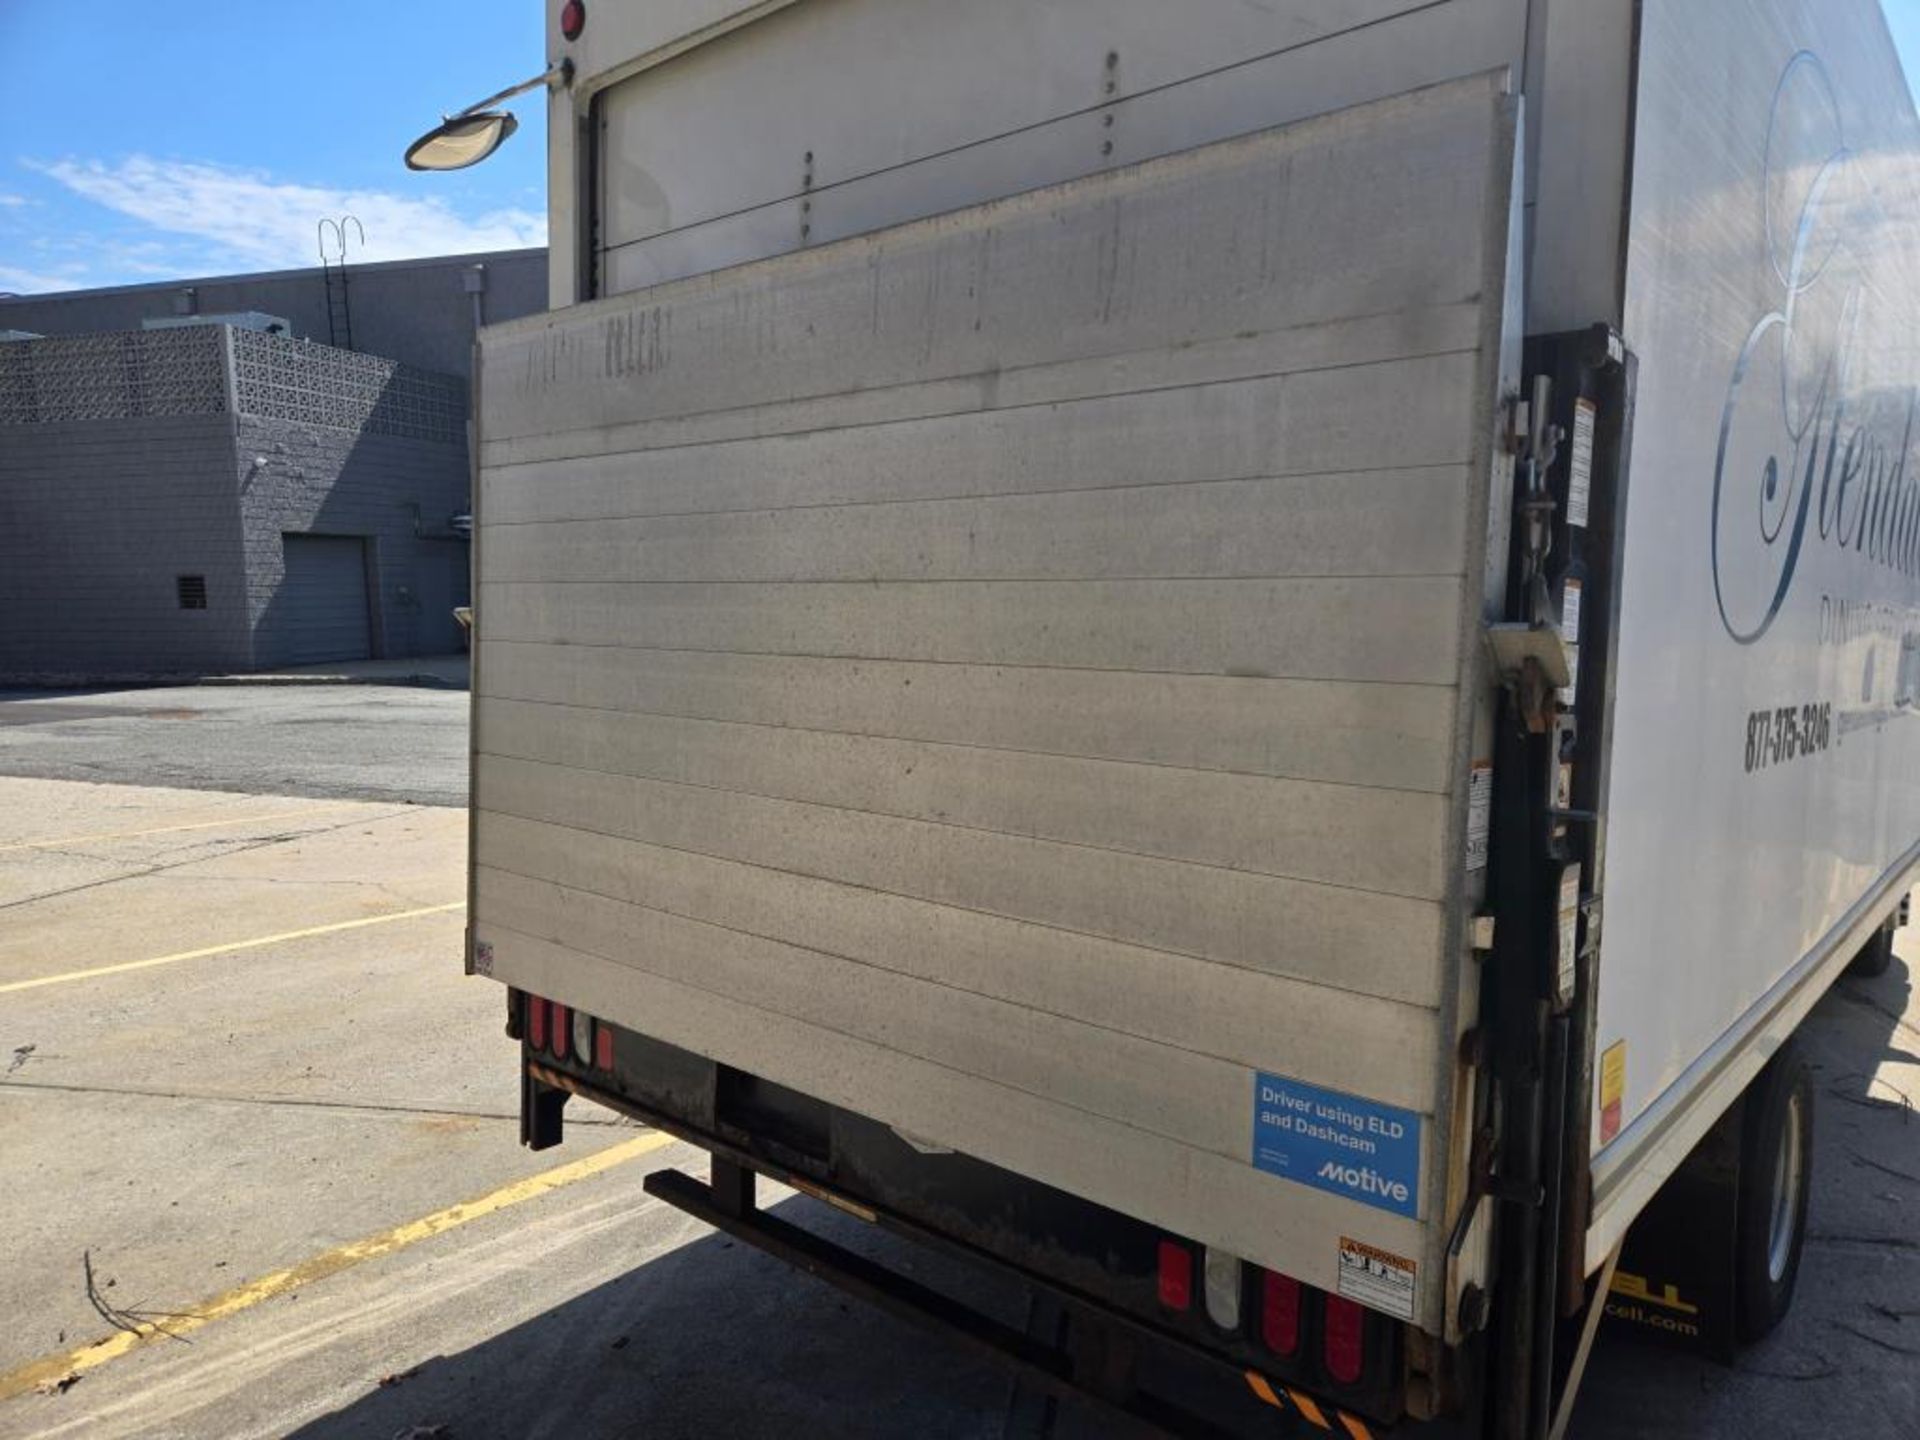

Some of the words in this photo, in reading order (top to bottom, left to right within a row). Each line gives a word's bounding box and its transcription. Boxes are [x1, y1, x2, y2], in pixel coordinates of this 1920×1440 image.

[1744, 701, 1831, 774] 877-375-3246
[1260, 1110, 1292, 1129] and
[1295, 1118, 1377, 1155] Dashcam
[1261, 1086, 1311, 1112] Driver
[1315, 1102, 1364, 1132] using
[1368, 1115, 1404, 1139] ELD
[1317, 1160, 1410, 1203] Motive
